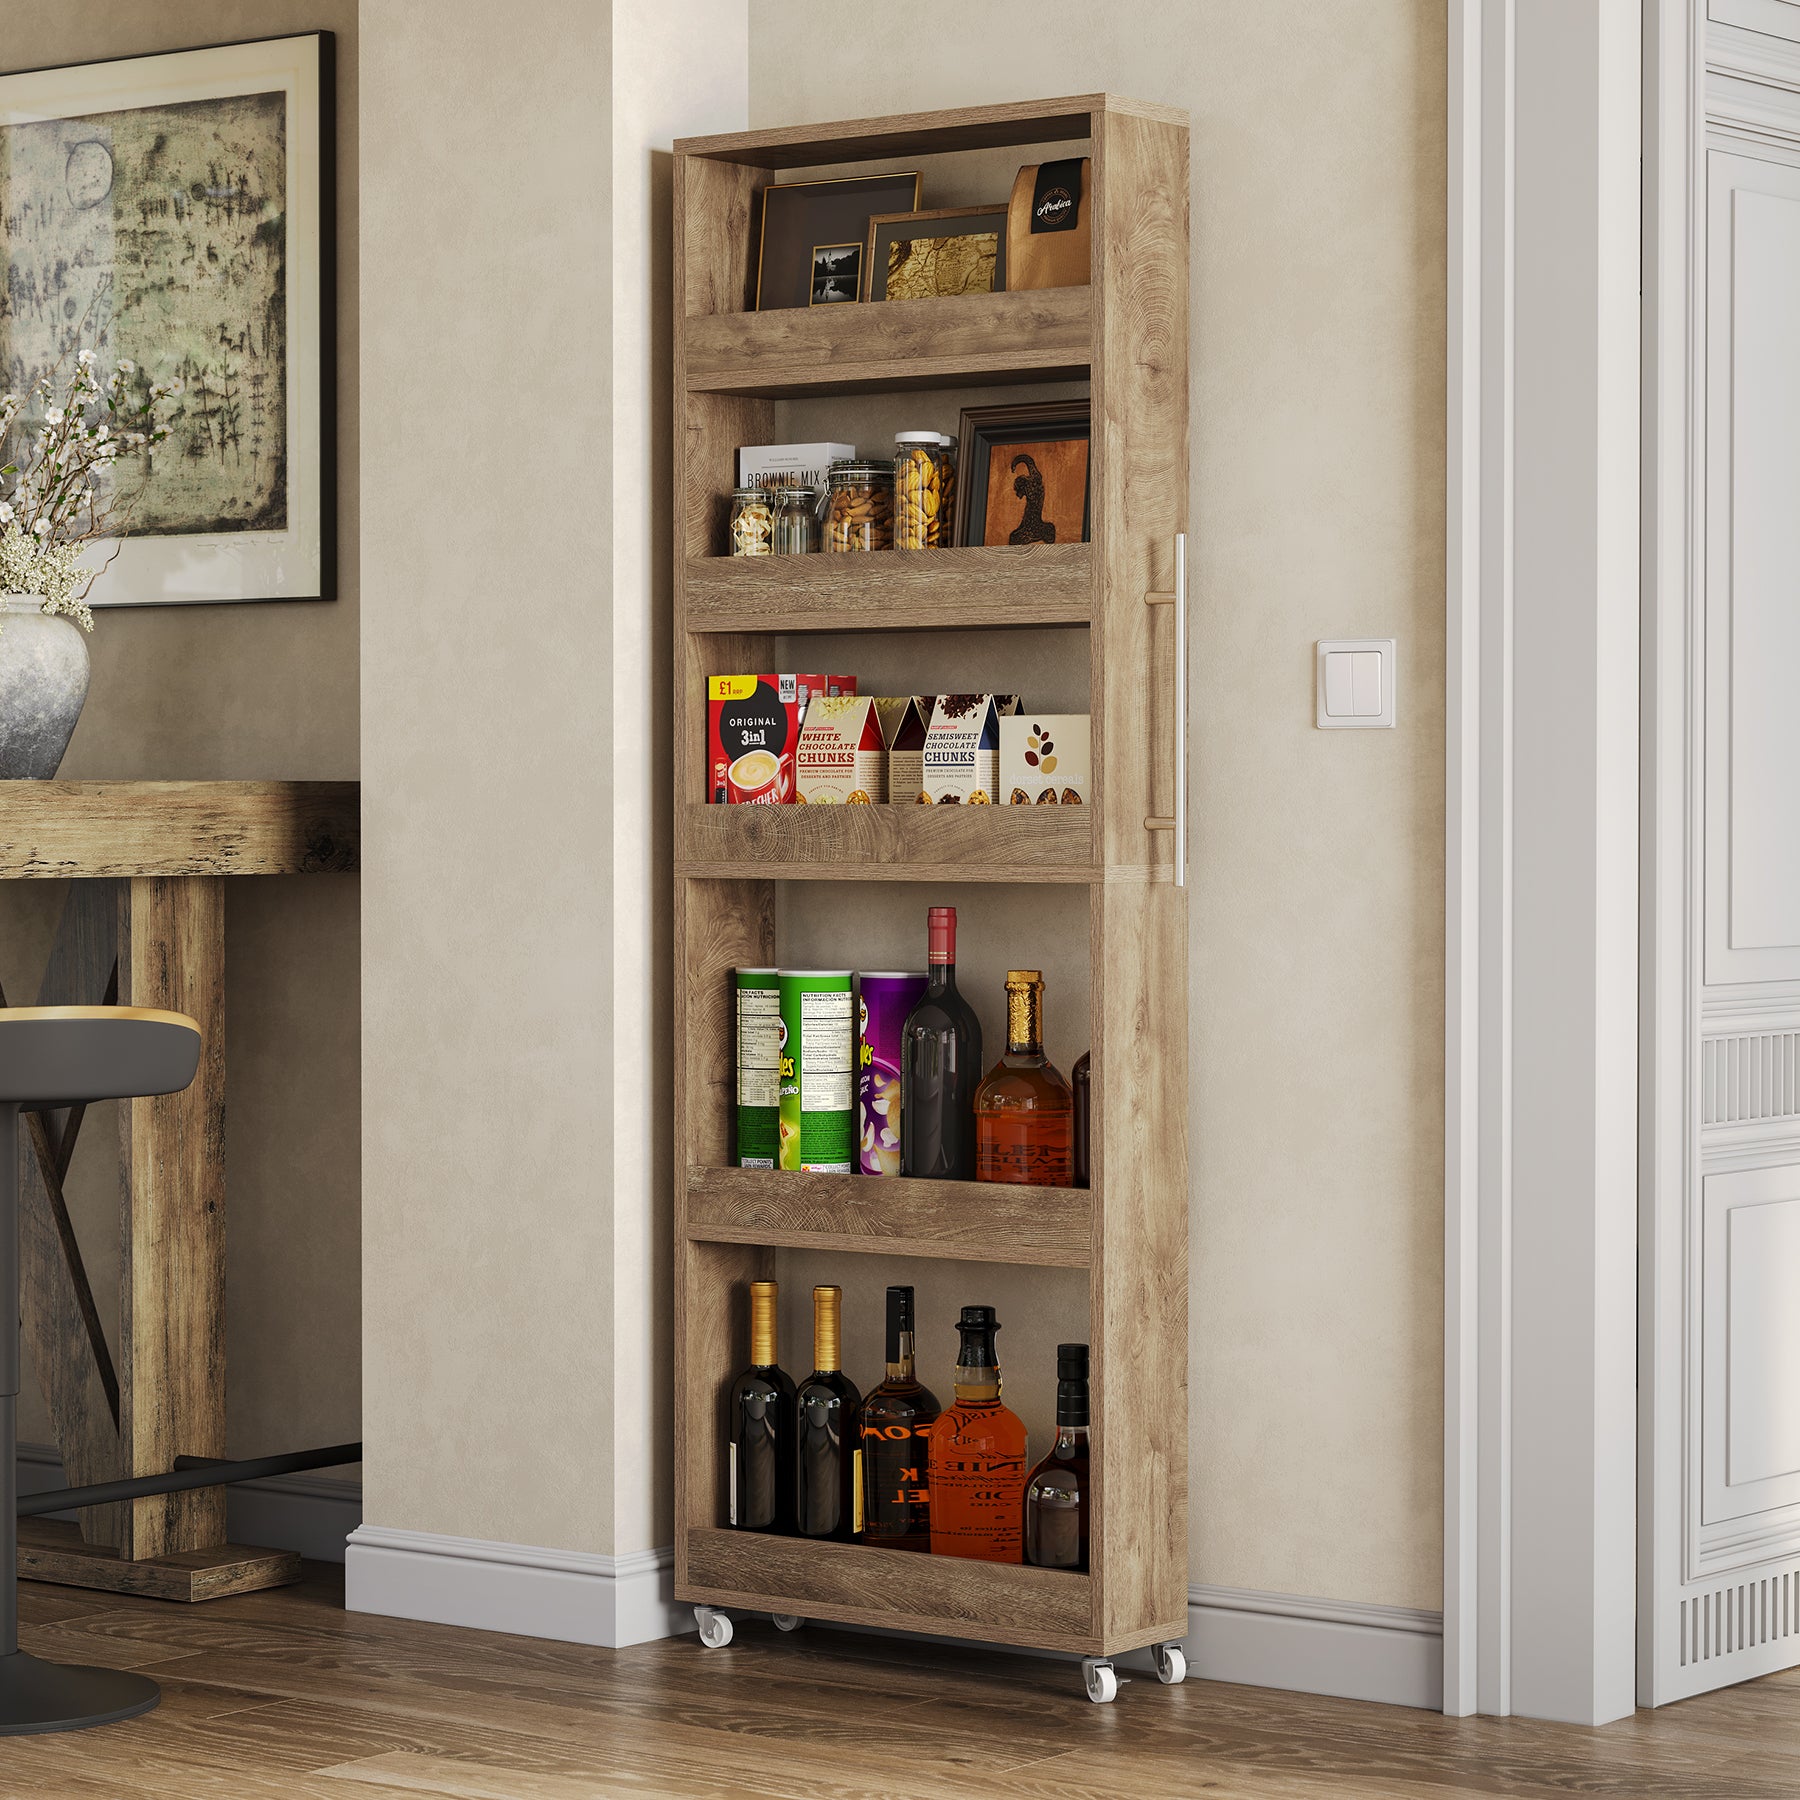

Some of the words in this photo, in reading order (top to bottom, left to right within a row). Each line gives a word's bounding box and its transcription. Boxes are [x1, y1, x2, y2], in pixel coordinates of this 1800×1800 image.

[1036, 199, 1072, 216] Arabica
[747, 471, 796, 489] BROWNIE
[801, 470, 820, 486] MIX
[719, 681, 732, 695] £1
[780, 679, 795, 690] NEW
[729, 717, 777, 727] ORIGINAL
[741, 729, 766, 746] 3in1
[802, 733, 841, 741] WHITE
[797, 752, 854, 763] CHUNKS
[924, 751, 975, 762] CHUNKS
[1010, 773, 1043, 784] dorset
[1046, 773, 1084, 785] cereals
